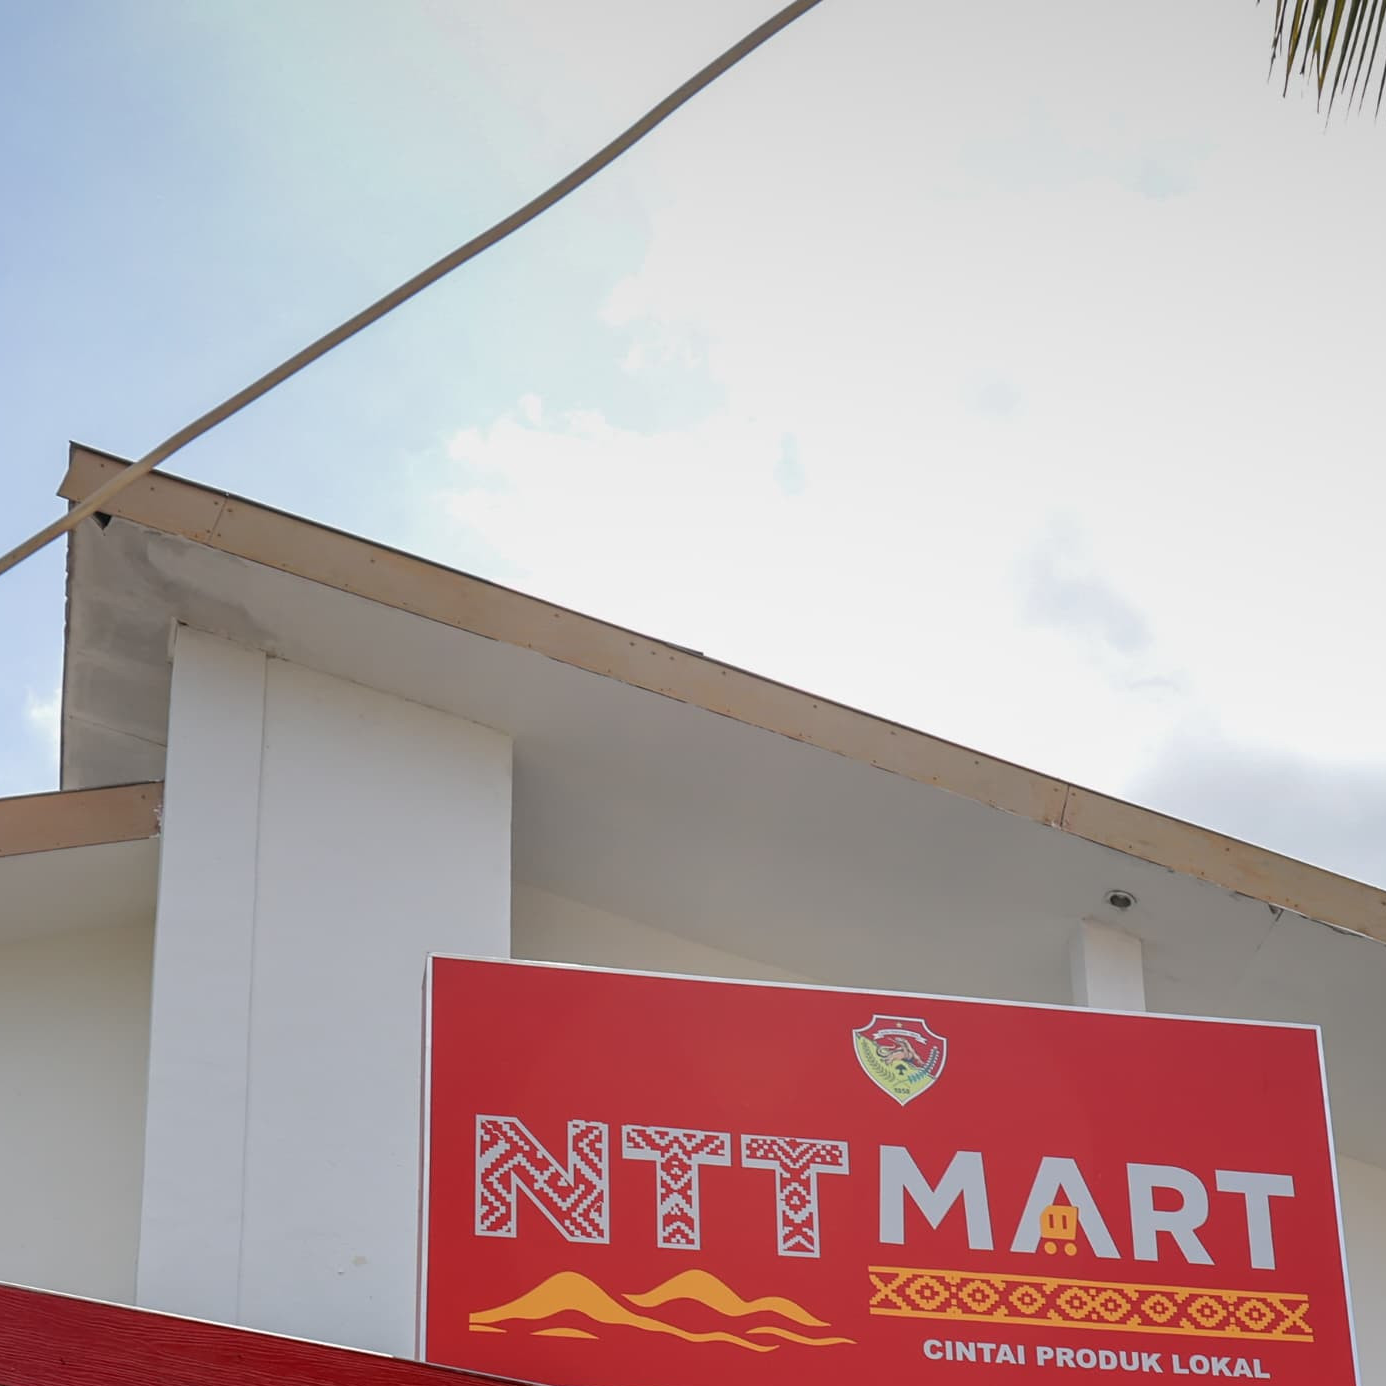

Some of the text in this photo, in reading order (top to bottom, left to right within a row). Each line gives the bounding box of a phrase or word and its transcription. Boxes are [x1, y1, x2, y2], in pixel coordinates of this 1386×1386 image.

[474, 1114, 1296, 1271] NTT MART
[923, 1339, 1271, 1379] CINTAI PRODUK LOKAL
